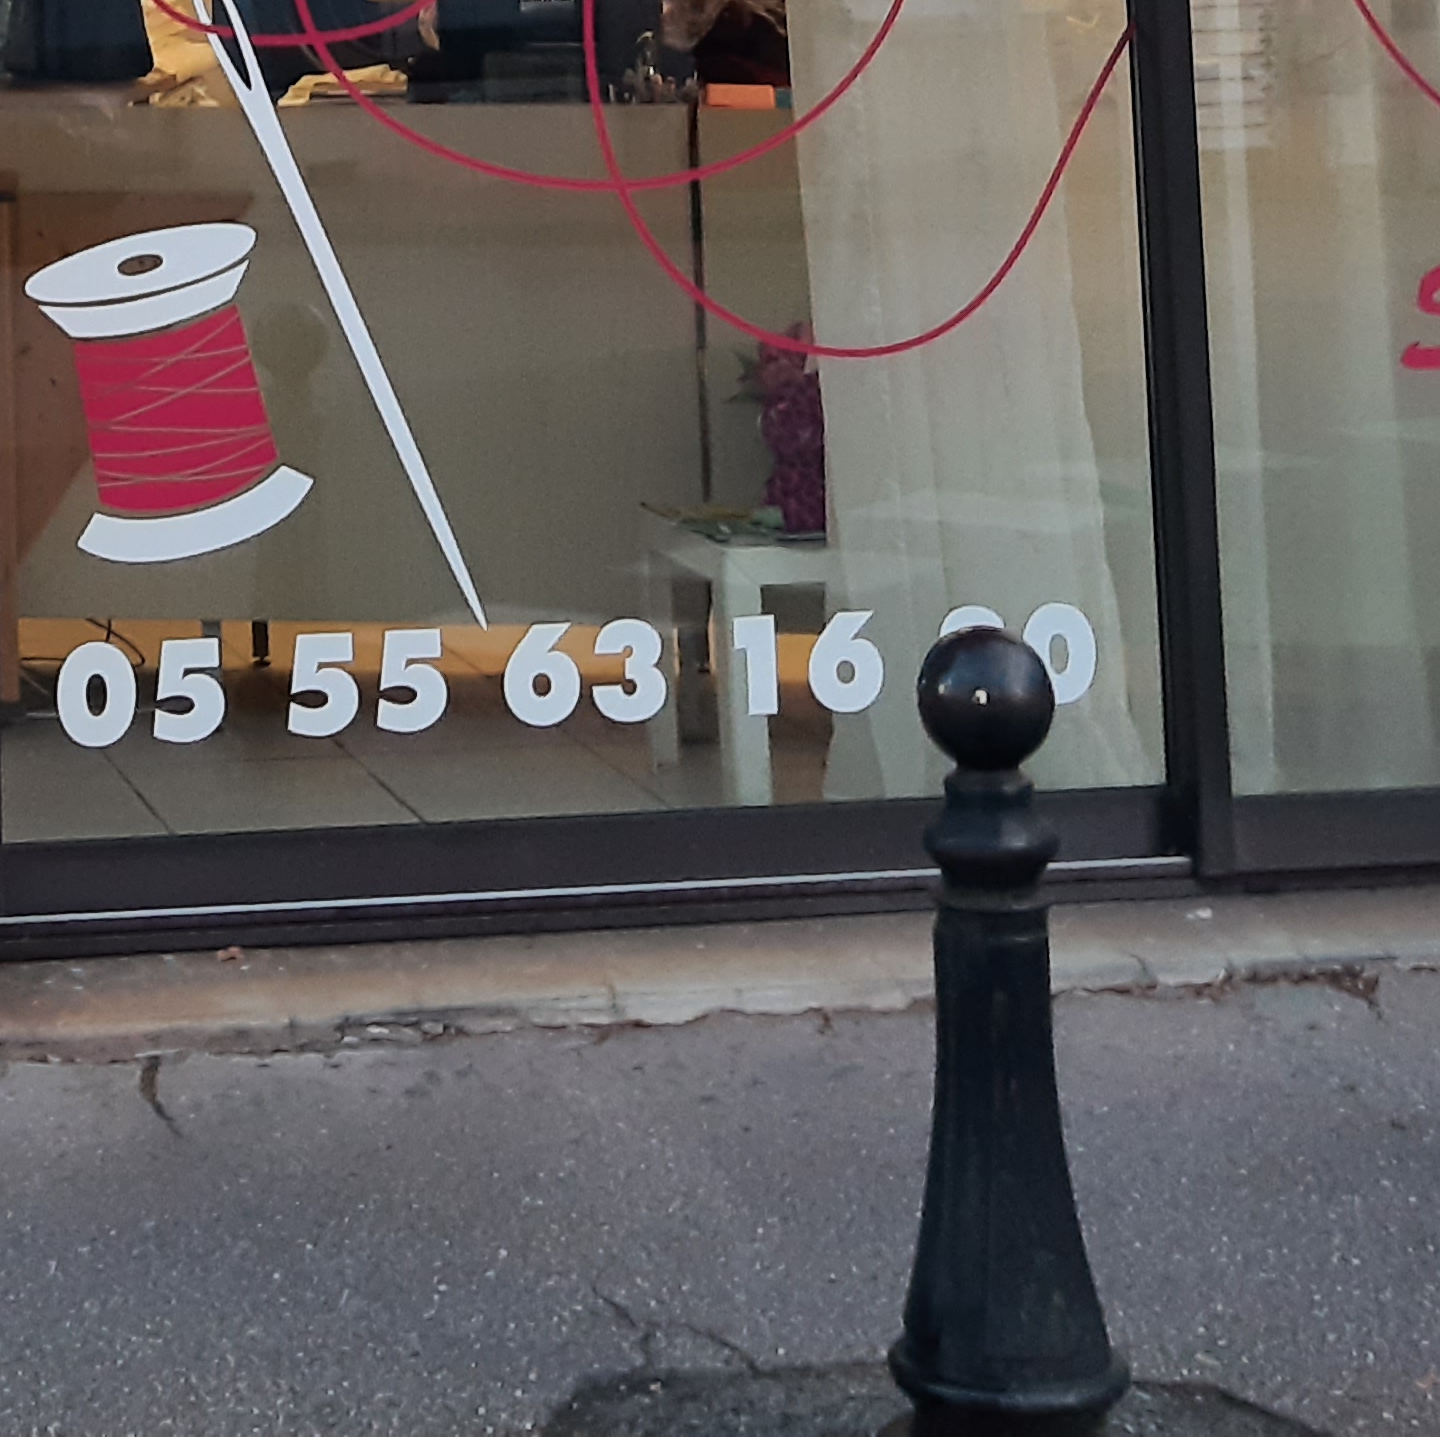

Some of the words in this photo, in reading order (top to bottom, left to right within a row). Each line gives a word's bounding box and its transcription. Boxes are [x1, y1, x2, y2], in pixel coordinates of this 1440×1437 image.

[53, 635, 228, 749] 05
[287, 627, 450, 739] 55
[502, 617, 668, 728] 63
[731, 608, 886, 717] 16
[938, 601, 1099, 707] 0
